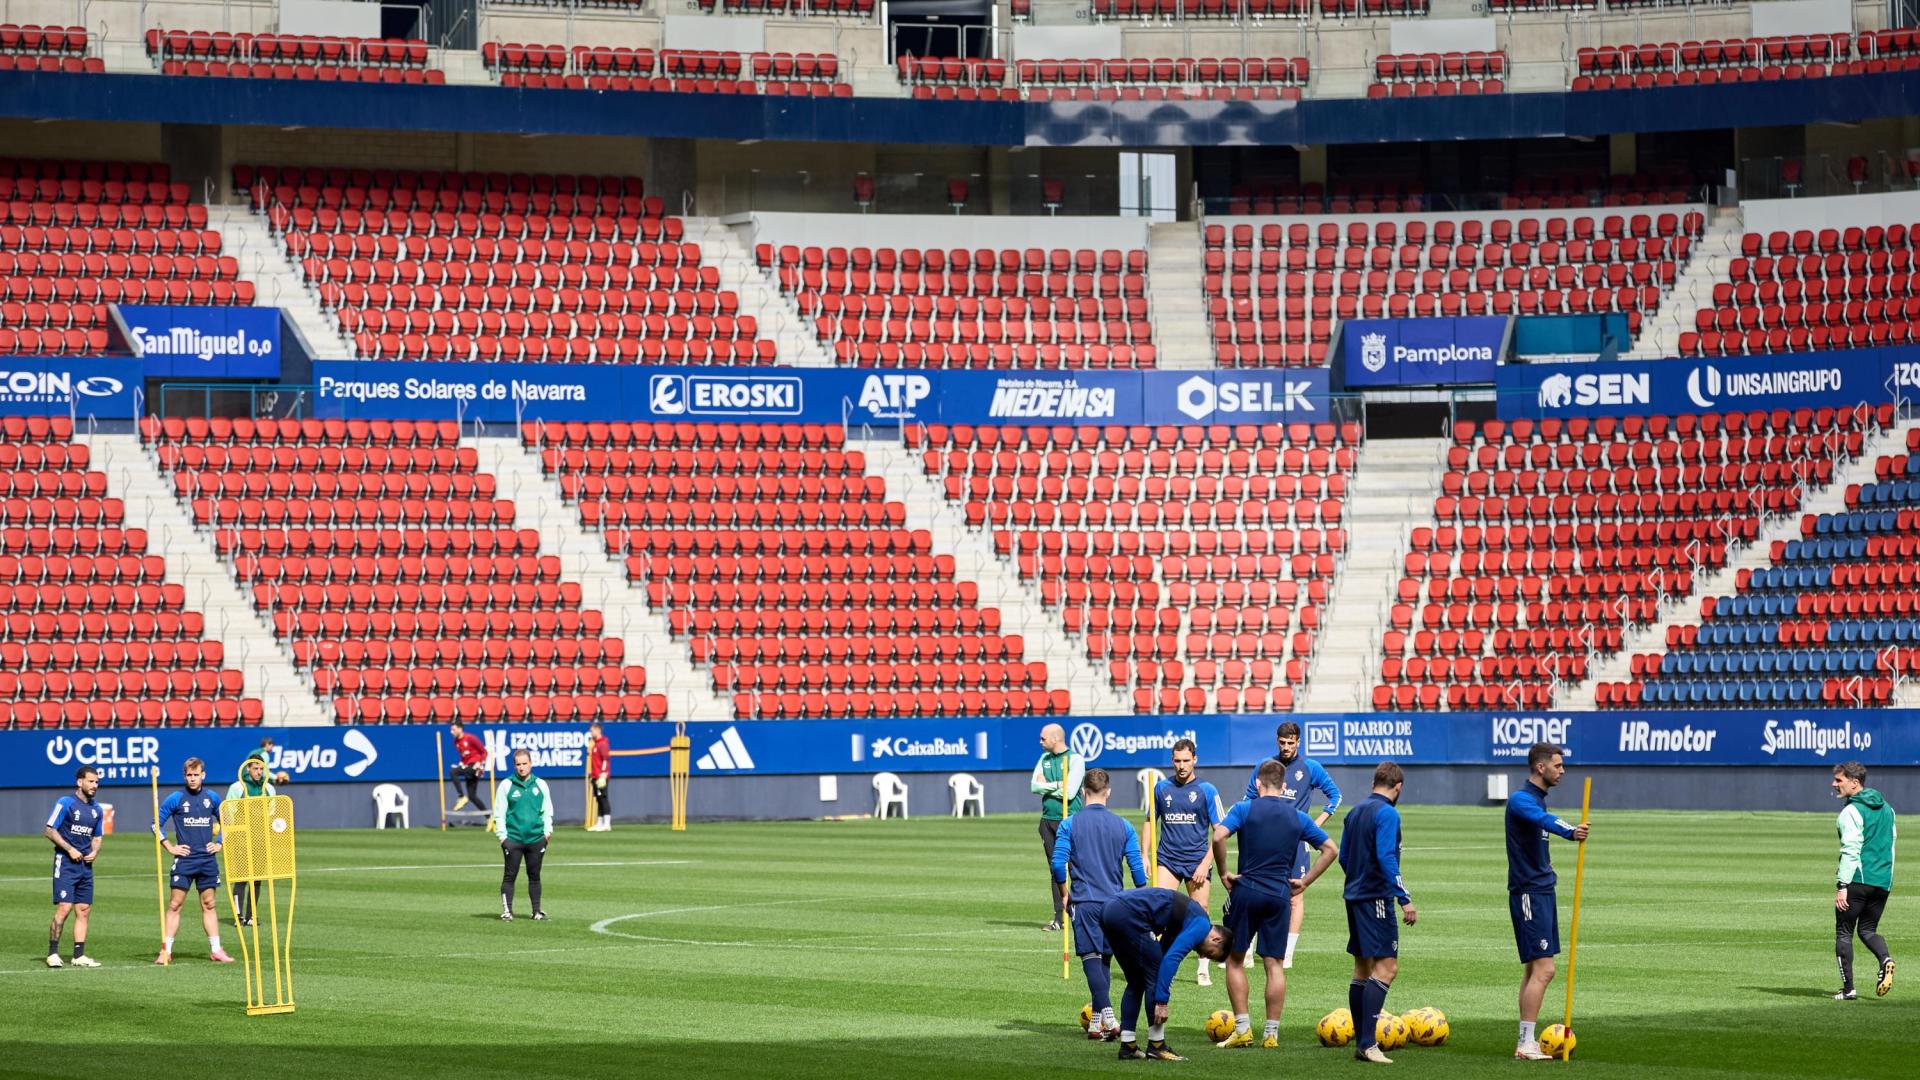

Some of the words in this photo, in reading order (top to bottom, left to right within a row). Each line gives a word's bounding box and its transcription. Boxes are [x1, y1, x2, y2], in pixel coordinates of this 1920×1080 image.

[1393, 343, 1492, 364] Pamplona
[319, 377, 400, 402] Parques
[404, 378, 477, 398] Solares
[481, 379, 507, 399] de
[511, 380, 586, 401] Navarra
[858, 374, 931, 407] ATP
[1575, 372, 1650, 406] SEN
[1726, 368, 1842, 397] UNSAINGRUPO
[694, 383, 795, 408] EROSKI
[1219, 381, 1316, 412] SELK
[1309, 727, 1334, 743] DN
[1343, 721, 1394, 737] DIARIO
[1395, 721, 1413, 736] DE
[1619, 721, 1717, 752] HRmotor
[75, 736, 160, 765] CELER
[268, 744, 338, 773] Jaylo
[529, 748, 583, 767] BAÑEZ
[893, 737, 968, 757] CaixaBank
[1344, 738, 1414, 755] NAVARRA
